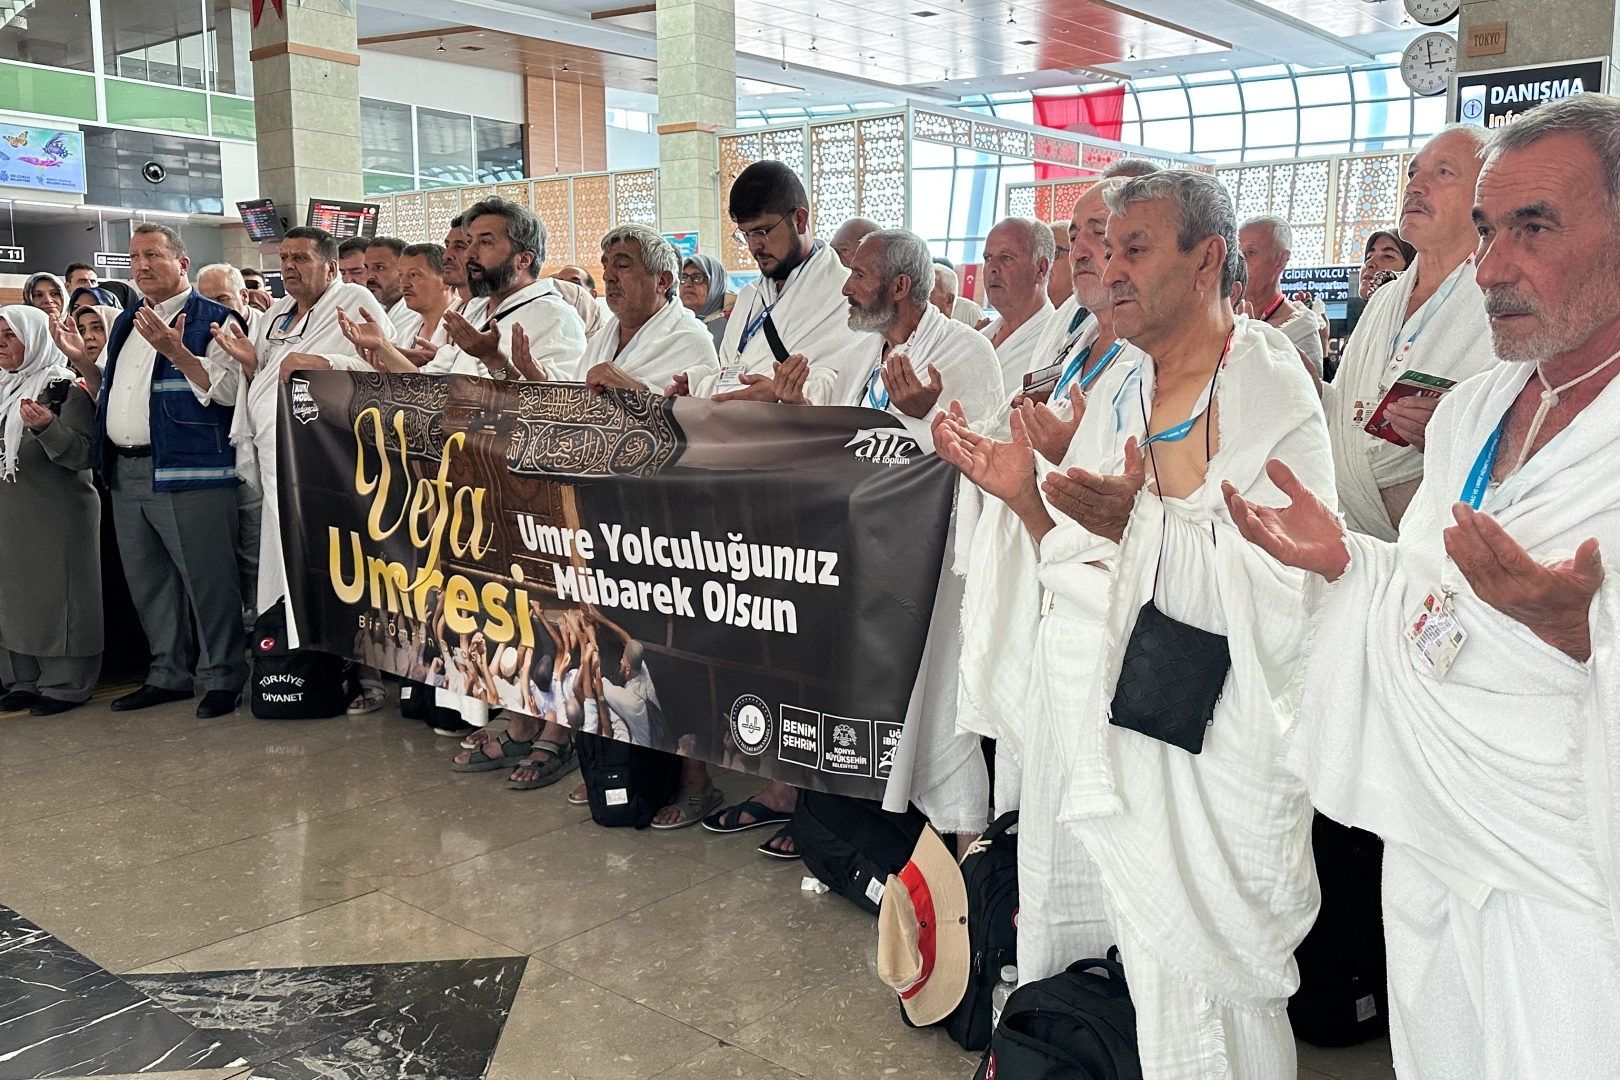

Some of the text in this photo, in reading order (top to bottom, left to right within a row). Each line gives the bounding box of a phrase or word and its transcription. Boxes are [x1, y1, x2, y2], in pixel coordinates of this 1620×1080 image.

[1474, 32, 1500, 47] TOKYO
[1491, 78, 1584, 104] DANIŞMA
[1489, 110, 1522, 128] Info
[8, 250, 20, 259] 11
[1285, 270, 1312, 280] GİDEN
[1315, 268, 1344, 278] YOLCU
[1280, 281, 1307, 290] mestic
[1314, 292, 1329, 300] 201
[1337, 291, 1348, 300] 20
[855, 432, 916, 458] aile
[882, 456, 910, 468] toplum
[354, 407, 494, 592] Vefa
[516, 514, 840, 587] Umre Yolculuğunuz
[329, 526, 535, 649] Umresi
[553, 562, 798, 634] Mübarek Olsun
[358, 615, 380, 631] Bir
[259, 674, 305, 688] TÜRKİYE
[262, 692, 304, 702] DİYANET
[889, 728, 902, 738] UĞ
[826, 752, 867, 765] BÜYÜKŞEHİR
[834, 747, 856, 756] KONYA
[880, 746, 898, 762] A
